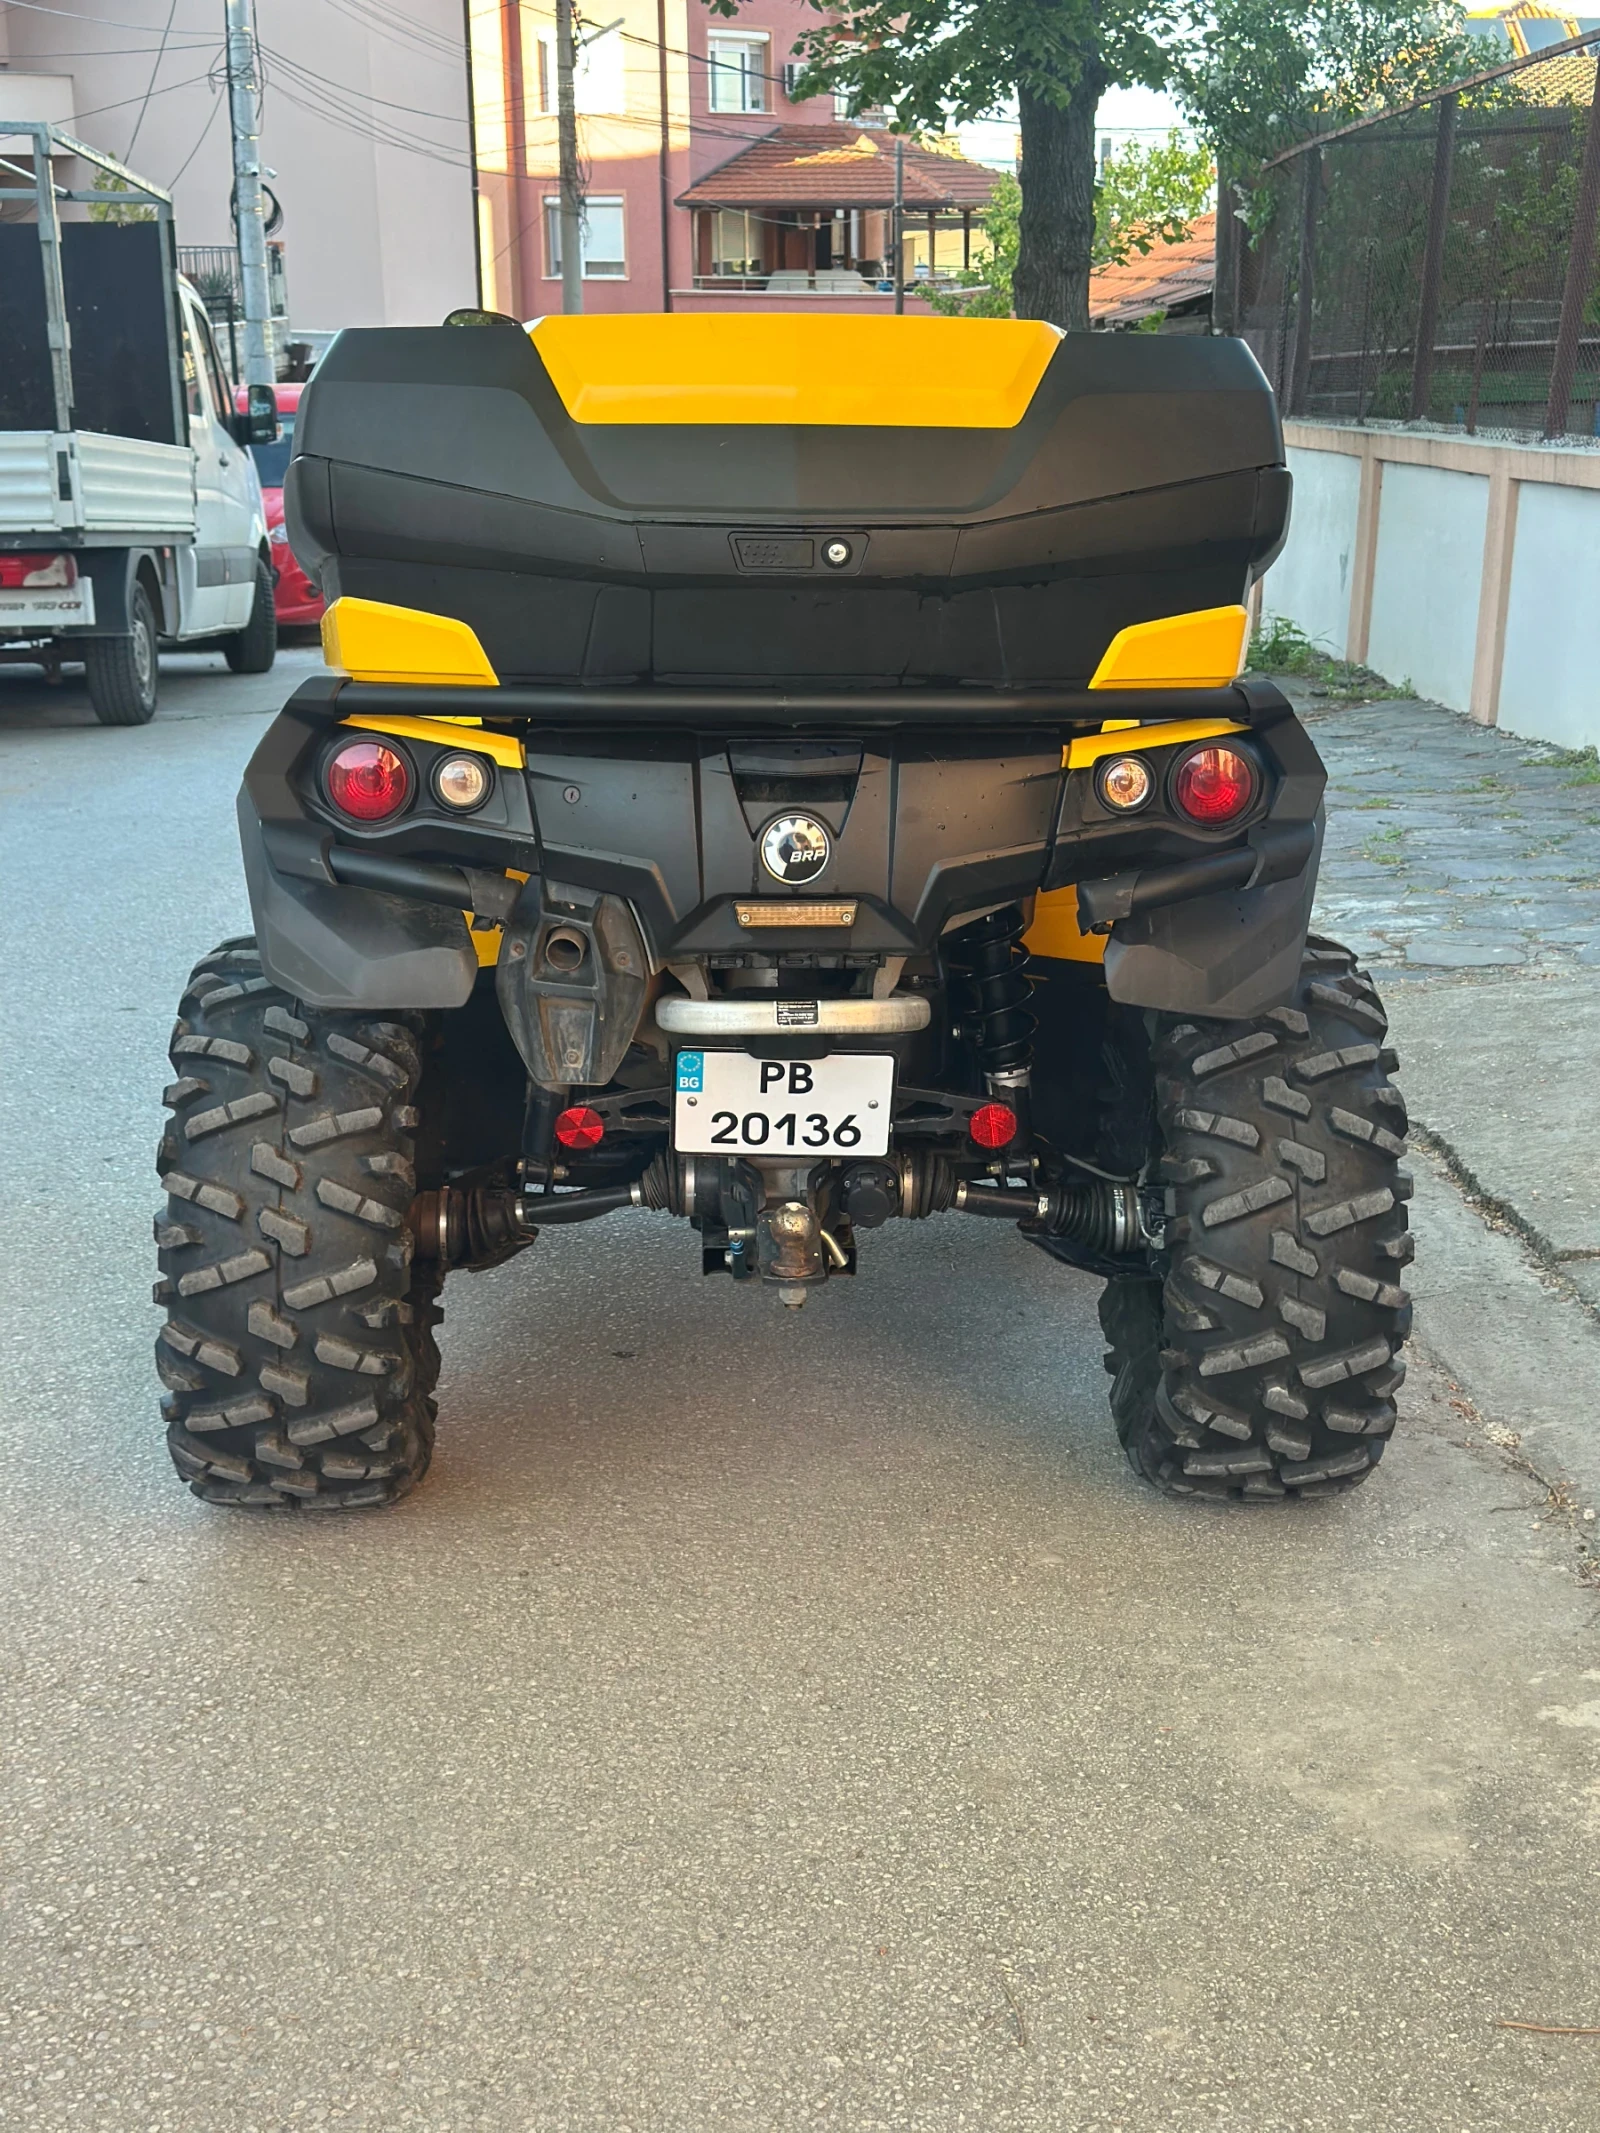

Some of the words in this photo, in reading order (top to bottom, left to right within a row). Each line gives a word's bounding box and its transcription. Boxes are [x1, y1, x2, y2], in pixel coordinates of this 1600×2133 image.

[789, 849, 826, 863] BRP
[679, 1077, 700, 1089] BG
[759, 1061, 814, 1095] PB
[710, 1111, 862, 1148] 20136
